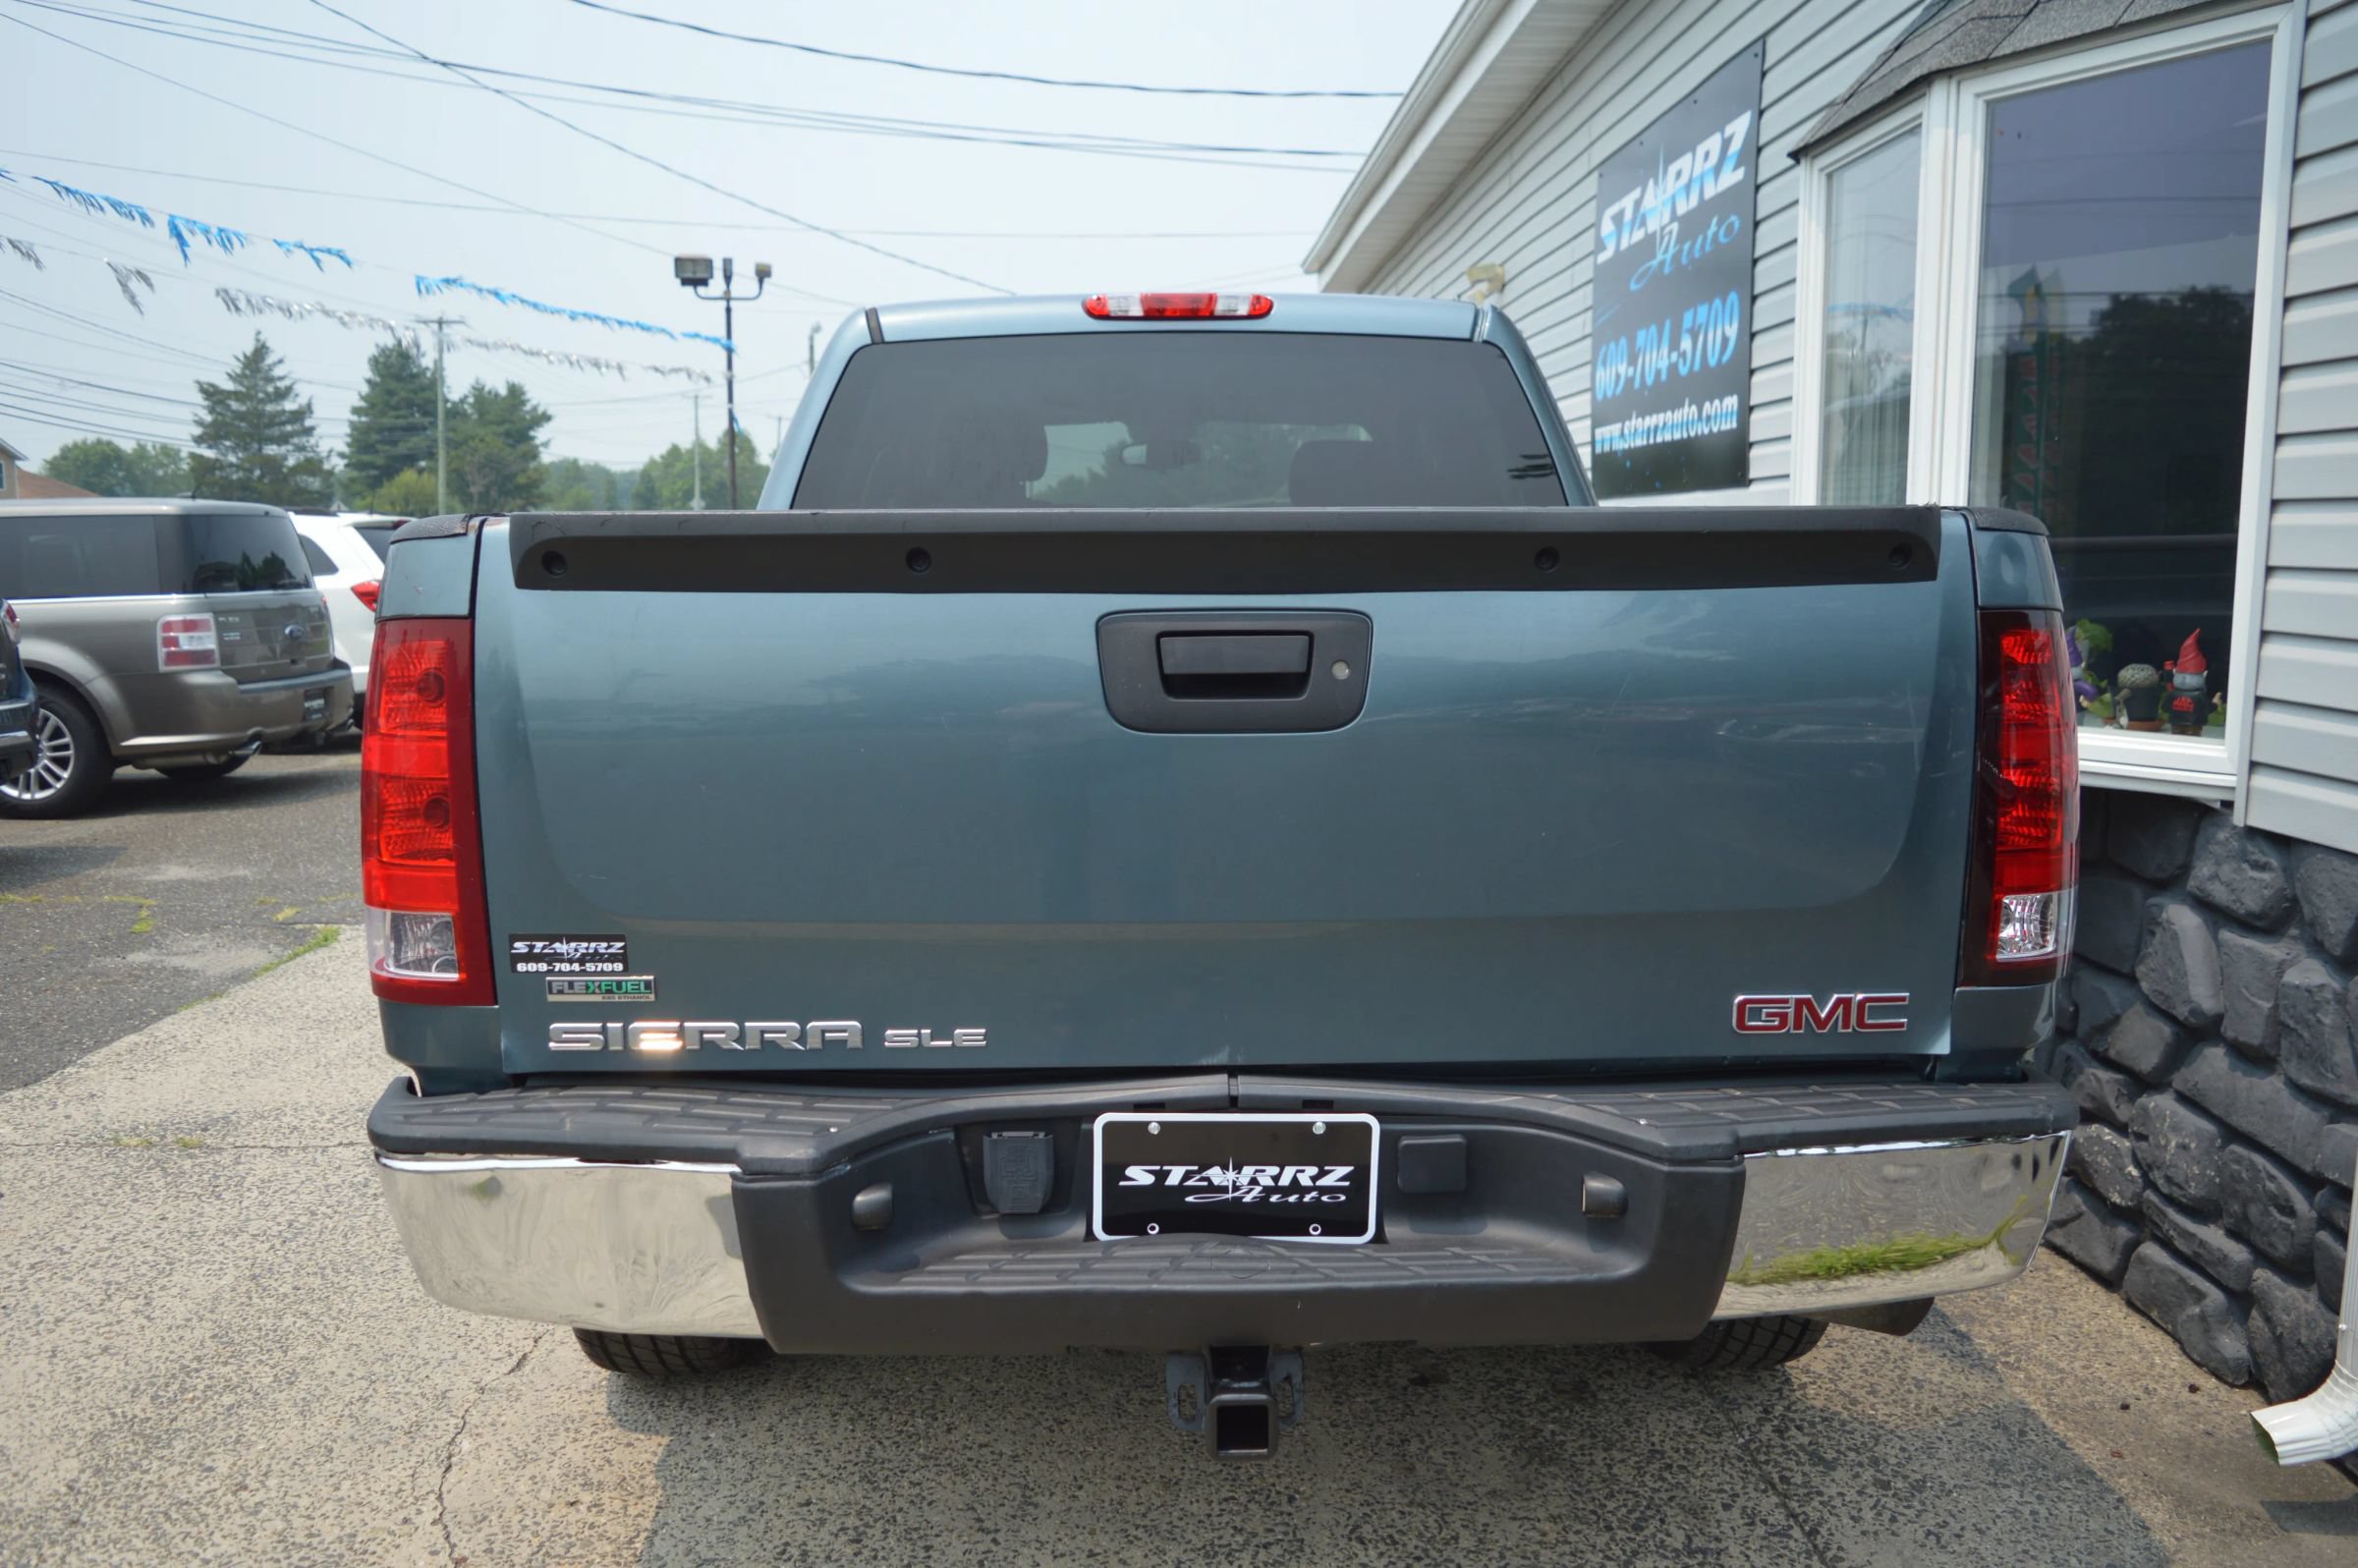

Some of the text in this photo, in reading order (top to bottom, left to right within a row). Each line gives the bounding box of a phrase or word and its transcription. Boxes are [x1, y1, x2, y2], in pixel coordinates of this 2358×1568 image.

[1597, 110, 1752, 264] STARRZ
[1629, 213, 1741, 291] Auto
[1595, 291, 1740, 403] 609-704-5709
[1595, 394, 1739, 455] www.starrzauto.com
[510, 941, 626, 953] STARRZ
[516, 962, 624, 973] 609-704-5709
[551, 980, 651, 994] FLEXFUEL
[1732, 992, 1910, 1033] GMC
[548, 1022, 986, 1051] SIERRA SLE
[1118, 1165, 1355, 1187] STARRZ
[1184, 1185, 1347, 1203] Auto
